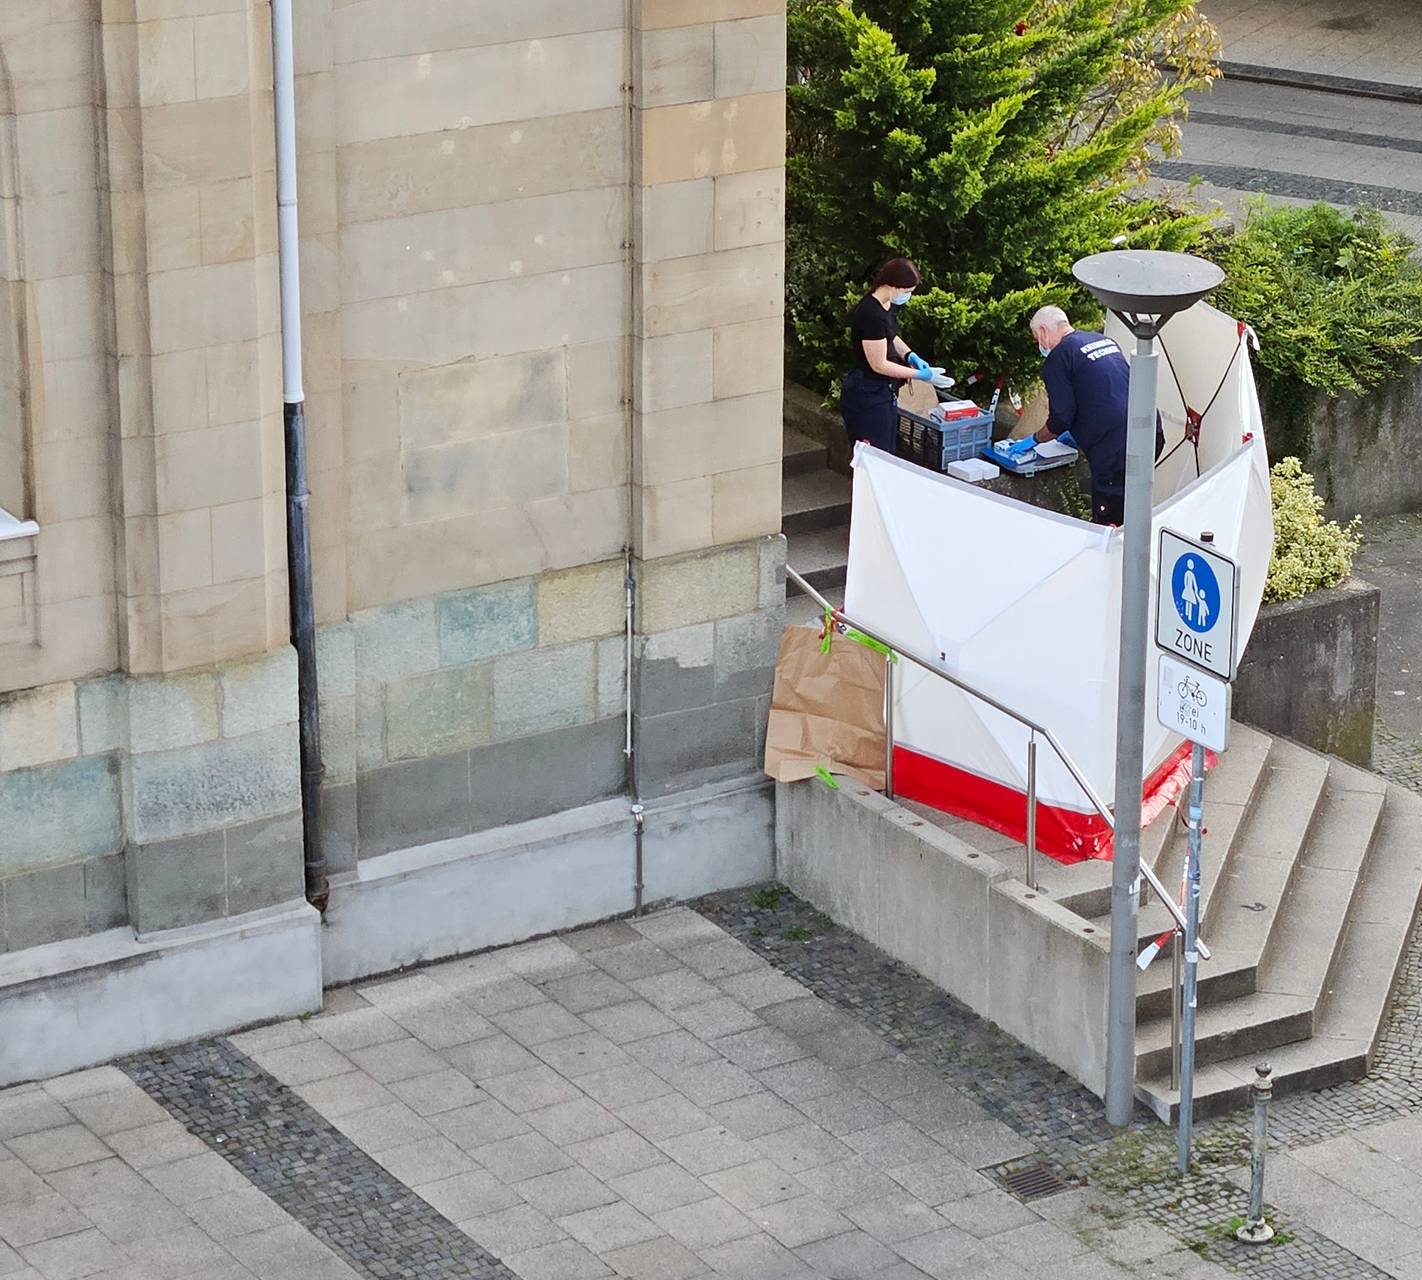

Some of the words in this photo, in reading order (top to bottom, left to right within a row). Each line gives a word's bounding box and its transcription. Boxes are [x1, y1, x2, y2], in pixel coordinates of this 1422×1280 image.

[1175, 628, 1212, 663] ZONE
[1176, 711, 1198, 731] 19-10
[1201, 723, 1206, 736] h
